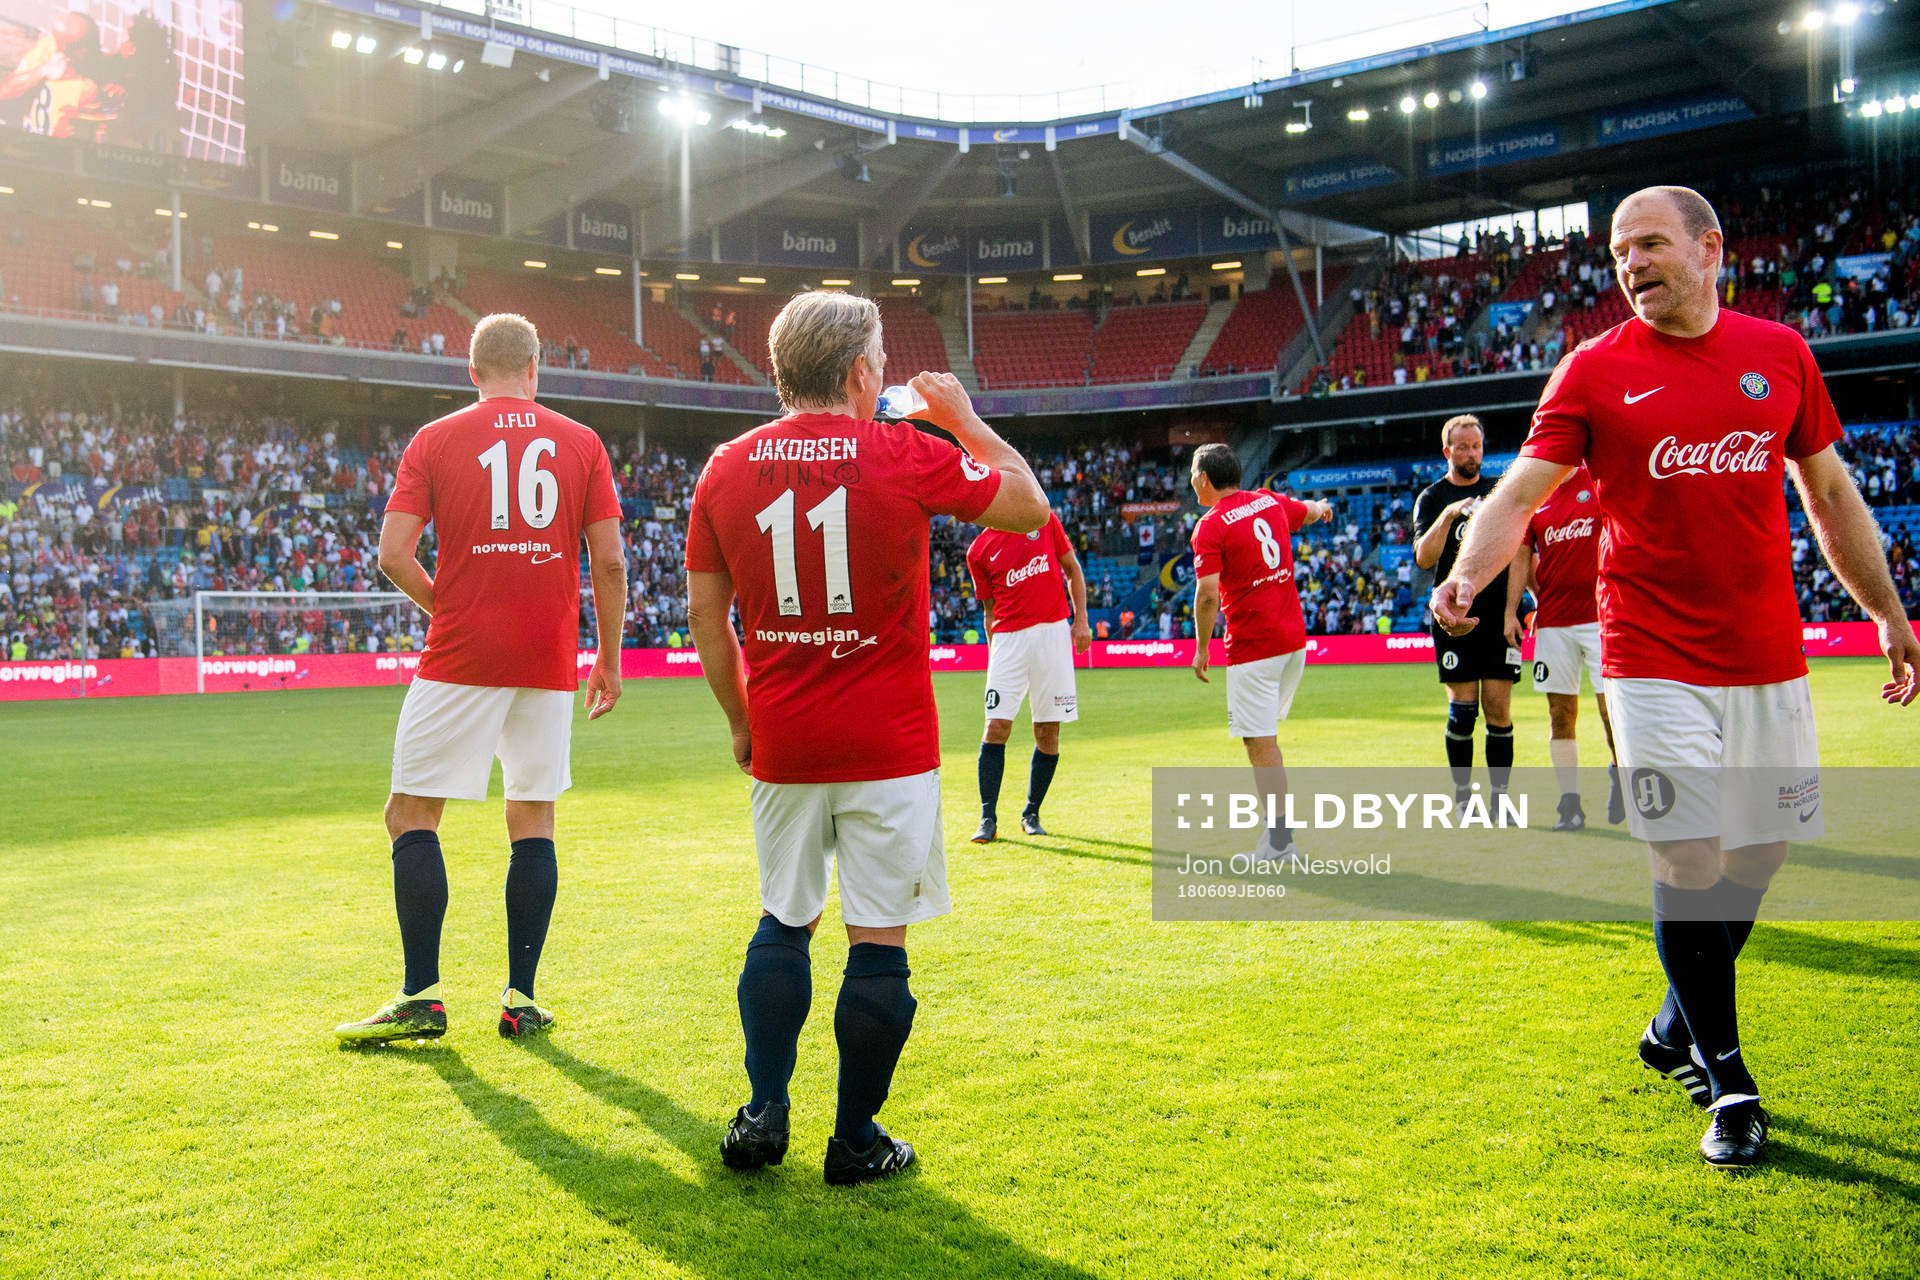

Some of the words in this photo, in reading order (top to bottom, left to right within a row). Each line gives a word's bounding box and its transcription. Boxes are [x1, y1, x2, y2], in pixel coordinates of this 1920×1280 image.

[527, 39, 544, 52] OG
[1623, 107, 1678, 131] NORSK
[1445, 142, 1495, 165] NORSK
[1499, 131, 1556, 154] TIPPING
[279, 163, 339, 196] bama
[1301, 172, 1347, 190] NORSK
[440, 192, 494, 220] bama
[580, 213, 628, 241] bama
[1128, 217, 1173, 246] Bendit
[782, 230, 837, 254] bama
[978, 239, 1034, 260] bama
[493, 412, 536, 429] J.FLO
[748, 437, 858, 462] JAKOBSEN
[1649, 431, 1776, 480] Coca-Cola
[477, 436, 559, 531] 16
[1311, 473, 1348, 484] NORSK
[1351, 467, 1393, 481] TIPPING
[1253, 517, 1281, 570] 8
[1544, 517, 1596, 546] Coca-Cola
[472, 540, 551, 555] norwegian
[754, 484, 854, 617] 11
[1006, 554, 1050, 588] Coca-Cola
[755, 627, 860, 646] norwegian
[1106, 641, 1174, 657] norwegian
[0, 661, 98, 684] orwegian
[202, 656, 297, 677] norwegian
[1778, 774, 1819, 796] BACALHAU
[1778, 801, 1791, 809] DA
[1793, 791, 1820, 809] NORUEGA
